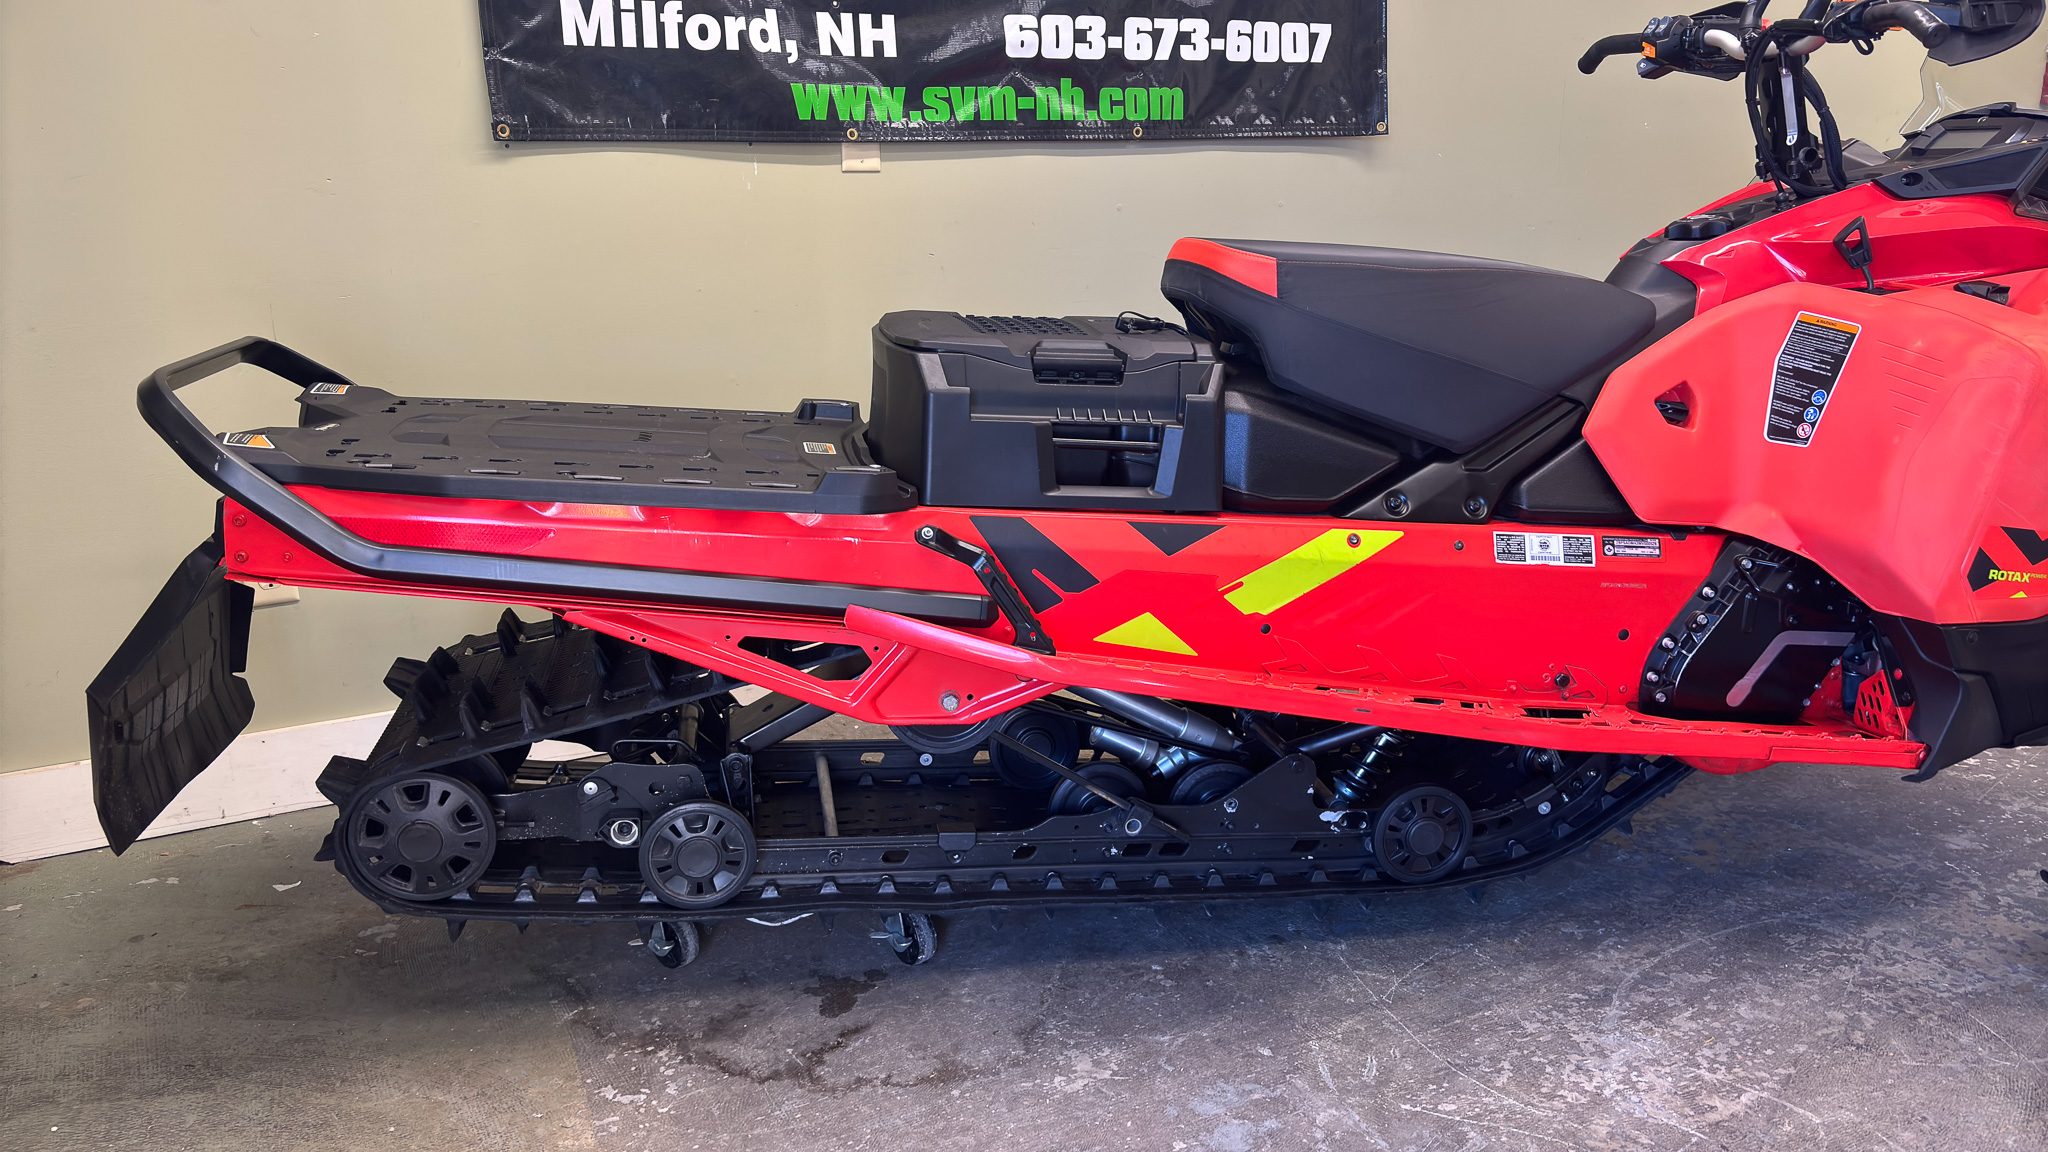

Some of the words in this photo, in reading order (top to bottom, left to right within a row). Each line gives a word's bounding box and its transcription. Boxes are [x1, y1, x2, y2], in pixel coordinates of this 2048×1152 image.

[560, 0, 799, 64] Milford,
[815, 11, 898, 58] NH
[1003, 14, 1332, 63] 603-673-6007
[791, 77, 1184, 122] www.svm-nh.com
[1988, 569, 2031, 583] ROTAX
